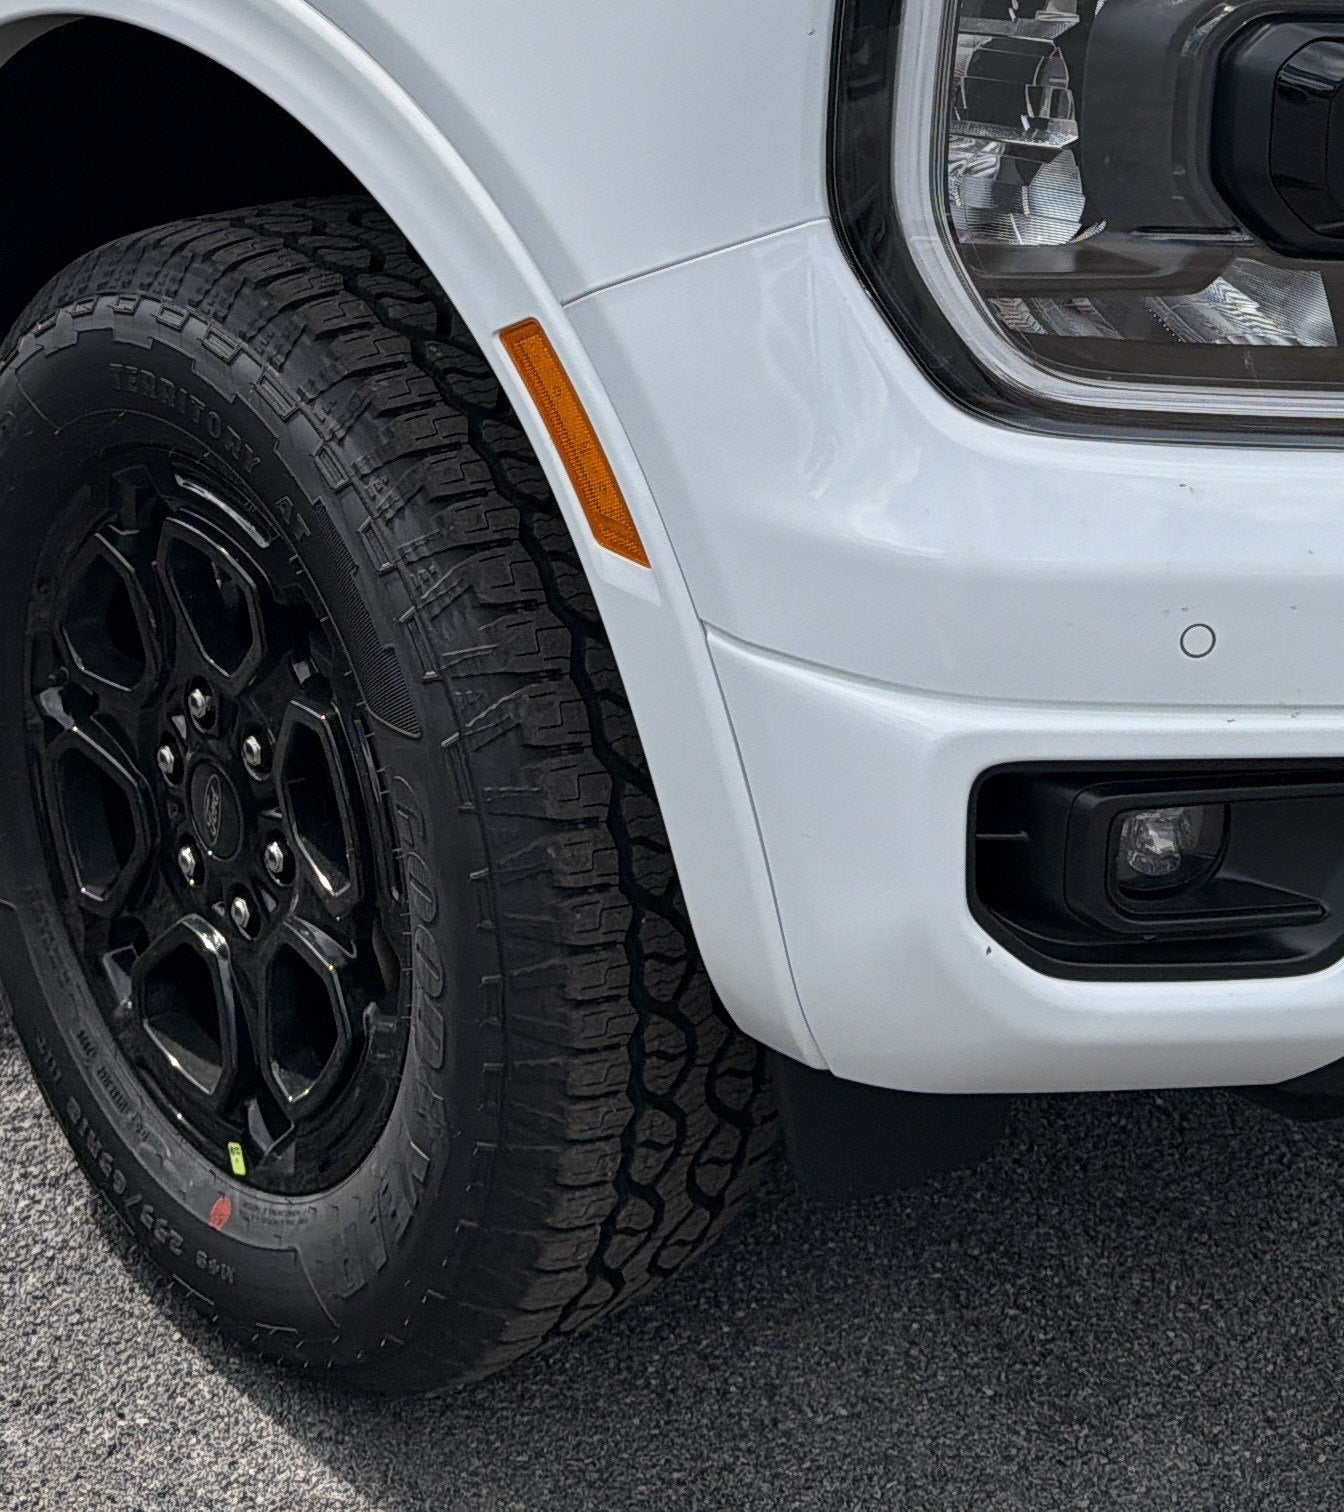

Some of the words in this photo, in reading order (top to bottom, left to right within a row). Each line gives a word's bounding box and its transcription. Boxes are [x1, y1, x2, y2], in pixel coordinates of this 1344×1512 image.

[109, 361, 262, 475] TERRITORY
[275, 494, 311, 542] AT
[338, 774, 448, 1300] GOODYEAR
